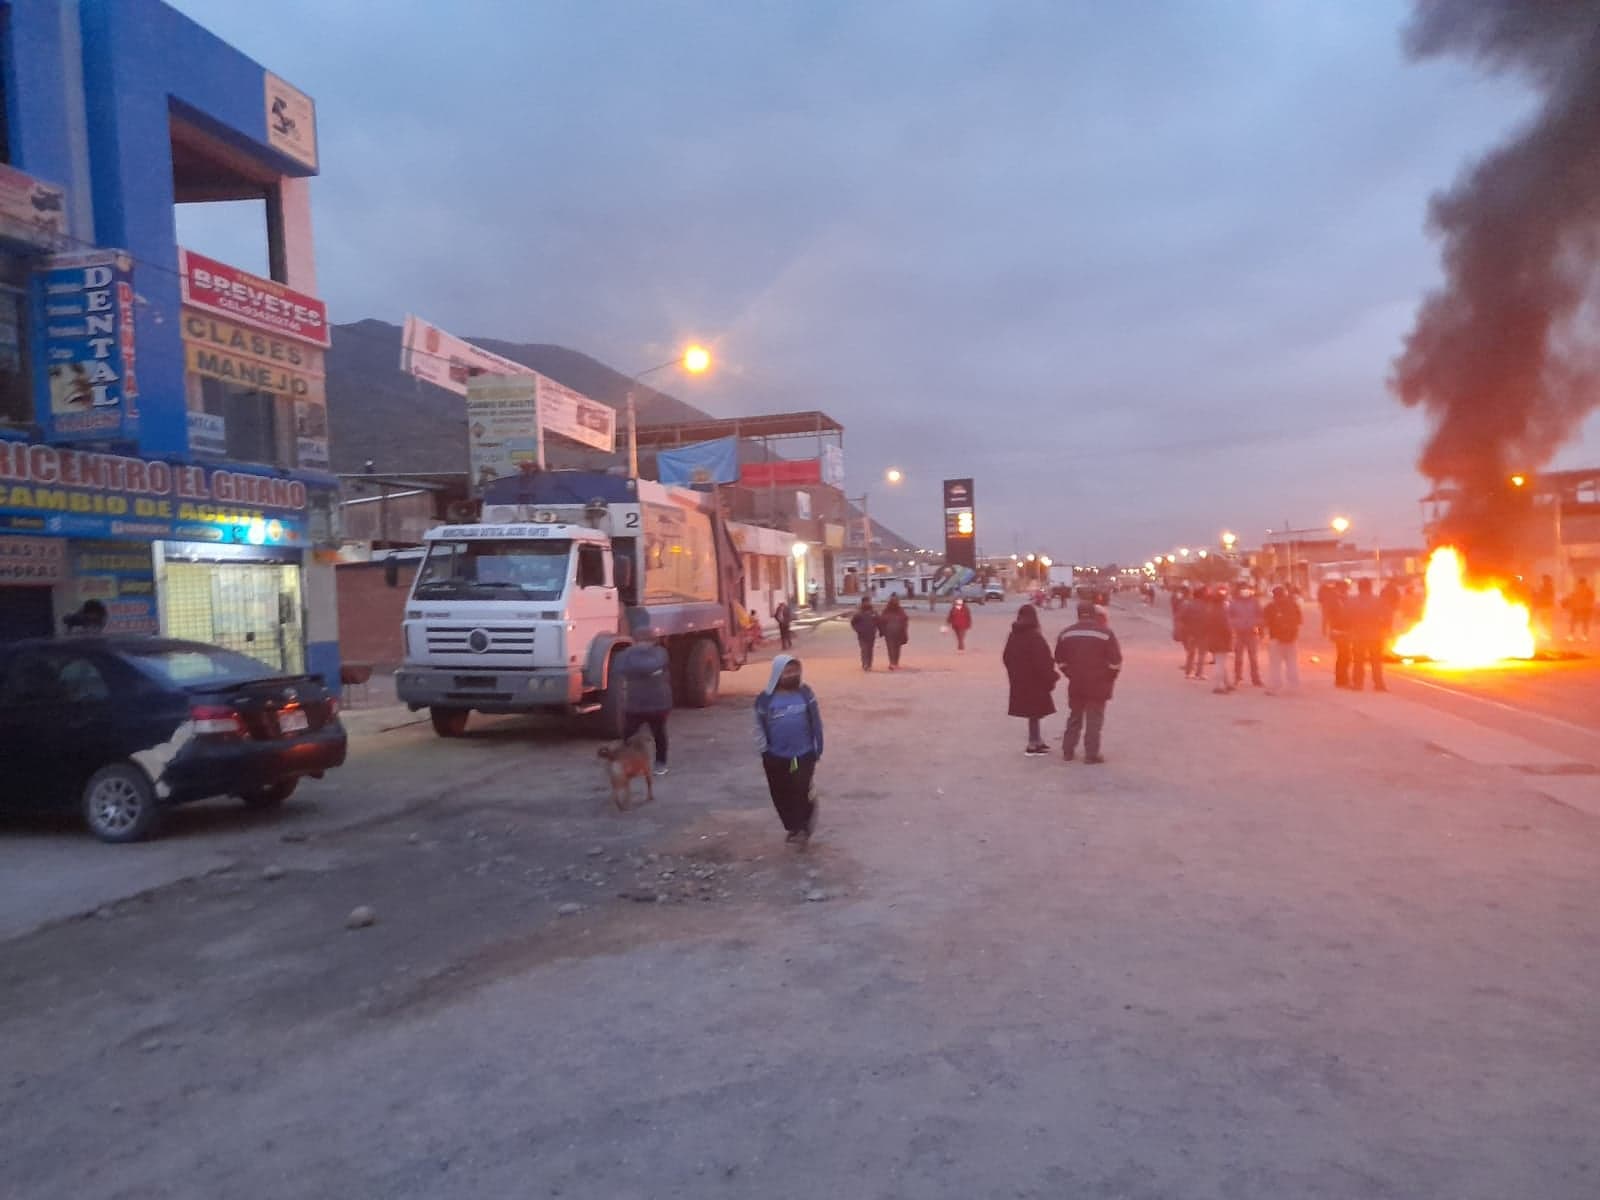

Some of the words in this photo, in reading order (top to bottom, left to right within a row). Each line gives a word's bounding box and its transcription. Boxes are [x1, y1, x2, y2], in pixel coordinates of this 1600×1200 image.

[193, 267, 321, 327] BREVETES
[82, 267, 120, 406] DENTAL
[187, 315, 302, 366] CLASES
[197, 348, 308, 397] MANEJO
[135, 498, 173, 518] DE
[176, 465, 209, 499] EL
[212, 470, 306, 510] GITANO
[625, 512, 639, 528] 2
